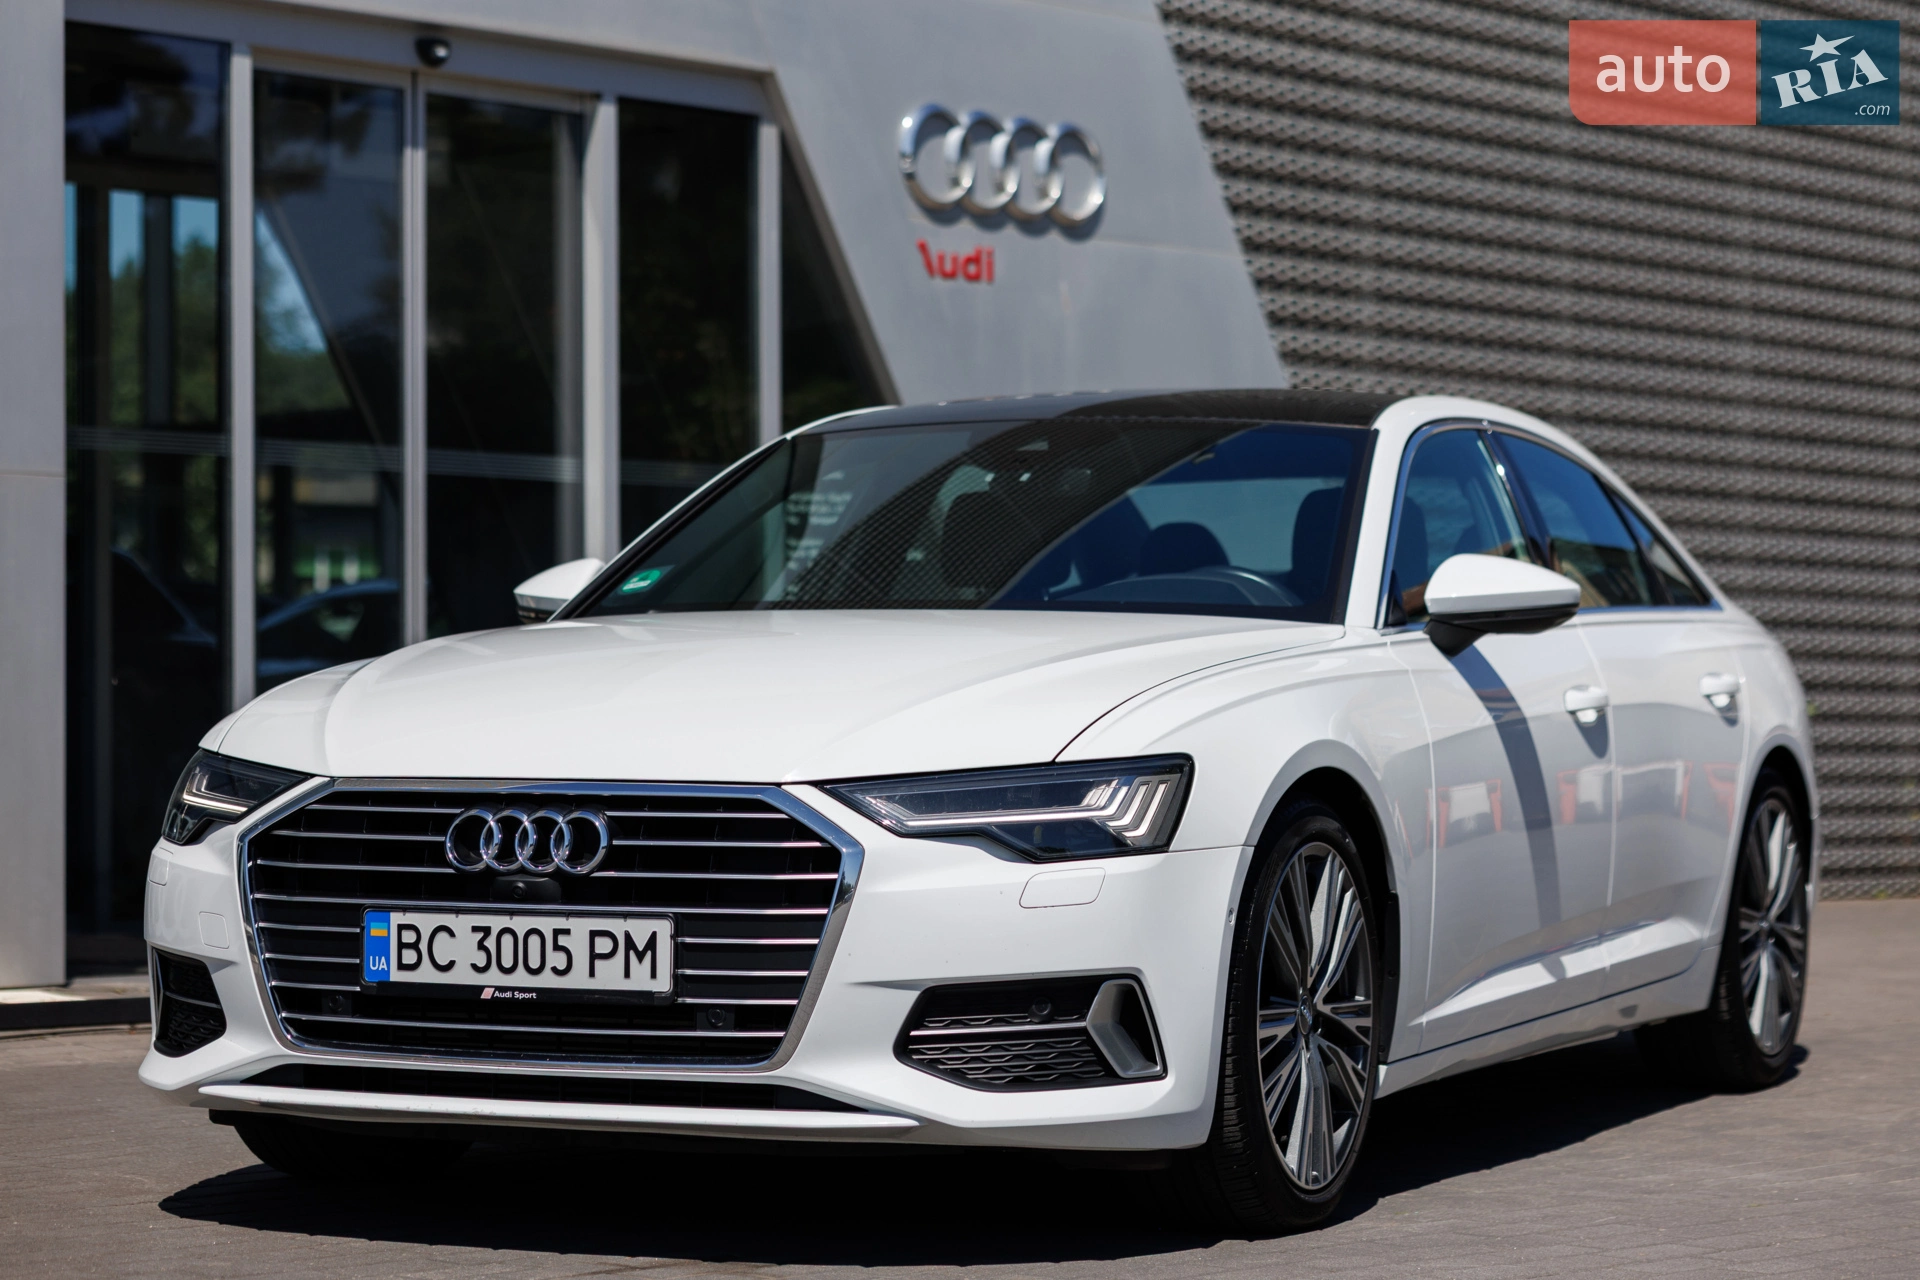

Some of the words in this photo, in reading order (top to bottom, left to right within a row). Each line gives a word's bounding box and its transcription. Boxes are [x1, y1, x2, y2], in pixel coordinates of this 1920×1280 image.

[396, 923, 457, 973] BC
[470, 926, 574, 976] 3005
[588, 929, 658, 979] PM
[369, 955, 388, 971] UA
[493, 990, 513, 999] Audi
[514, 991, 537, 1000] Sport
